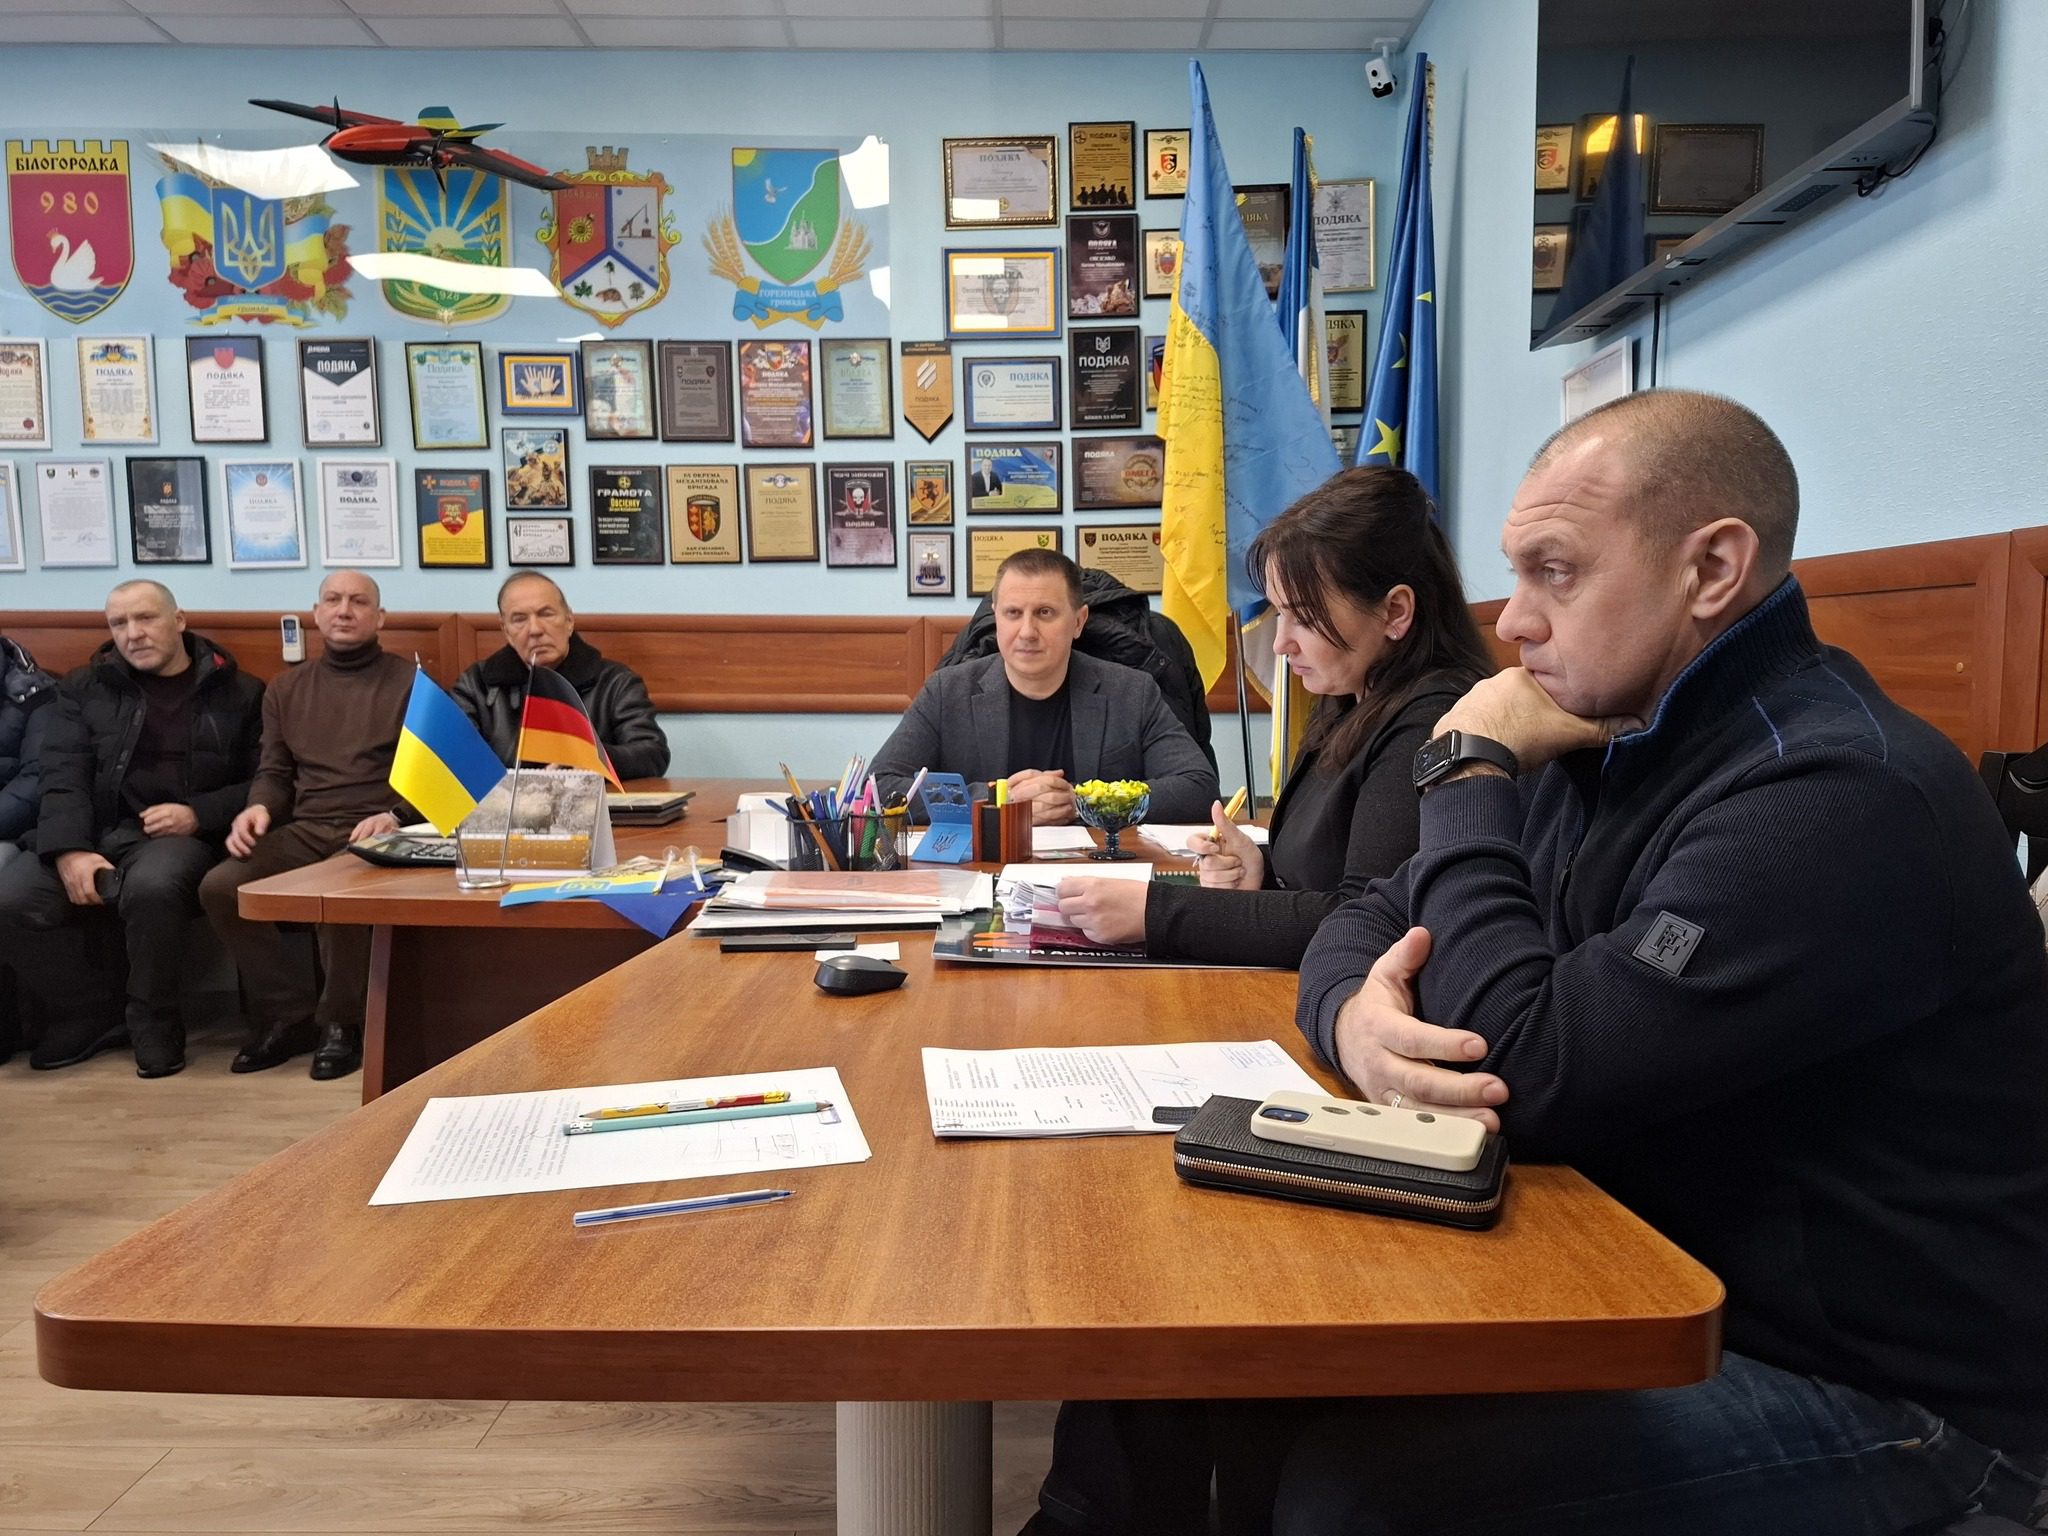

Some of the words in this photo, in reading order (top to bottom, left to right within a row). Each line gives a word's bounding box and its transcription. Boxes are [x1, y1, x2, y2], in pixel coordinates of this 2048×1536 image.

[979, 153, 1021, 162] ПОДЯКА
[15, 157, 119, 172] БІЛОГОРОДКА
[759, 288, 817, 298] ГОРЕНИЦЬКА
[317, 360, 357, 373] ПОДЯКА
[1079, 356, 1130, 368] ПОДЯКА
[206, 372, 245, 380] ПОДЯКА
[1009, 372, 1049, 382] ПОДЯКА
[976, 448, 1022, 457] ПОДЯКА
[1084, 451, 1116, 459] ПОДЯКА
[1125, 470, 1157, 478] ОМЕГА
[597, 489, 653, 497] ГРАМОТА
[339, 496, 378, 504] ПОДЯКА
[1101, 533, 1148, 542] ПОДЯКА
[973, 946, 1046, 956] ТРЕТІЙ
[1049, 950, 1147, 958] АРМІЙСЬ
